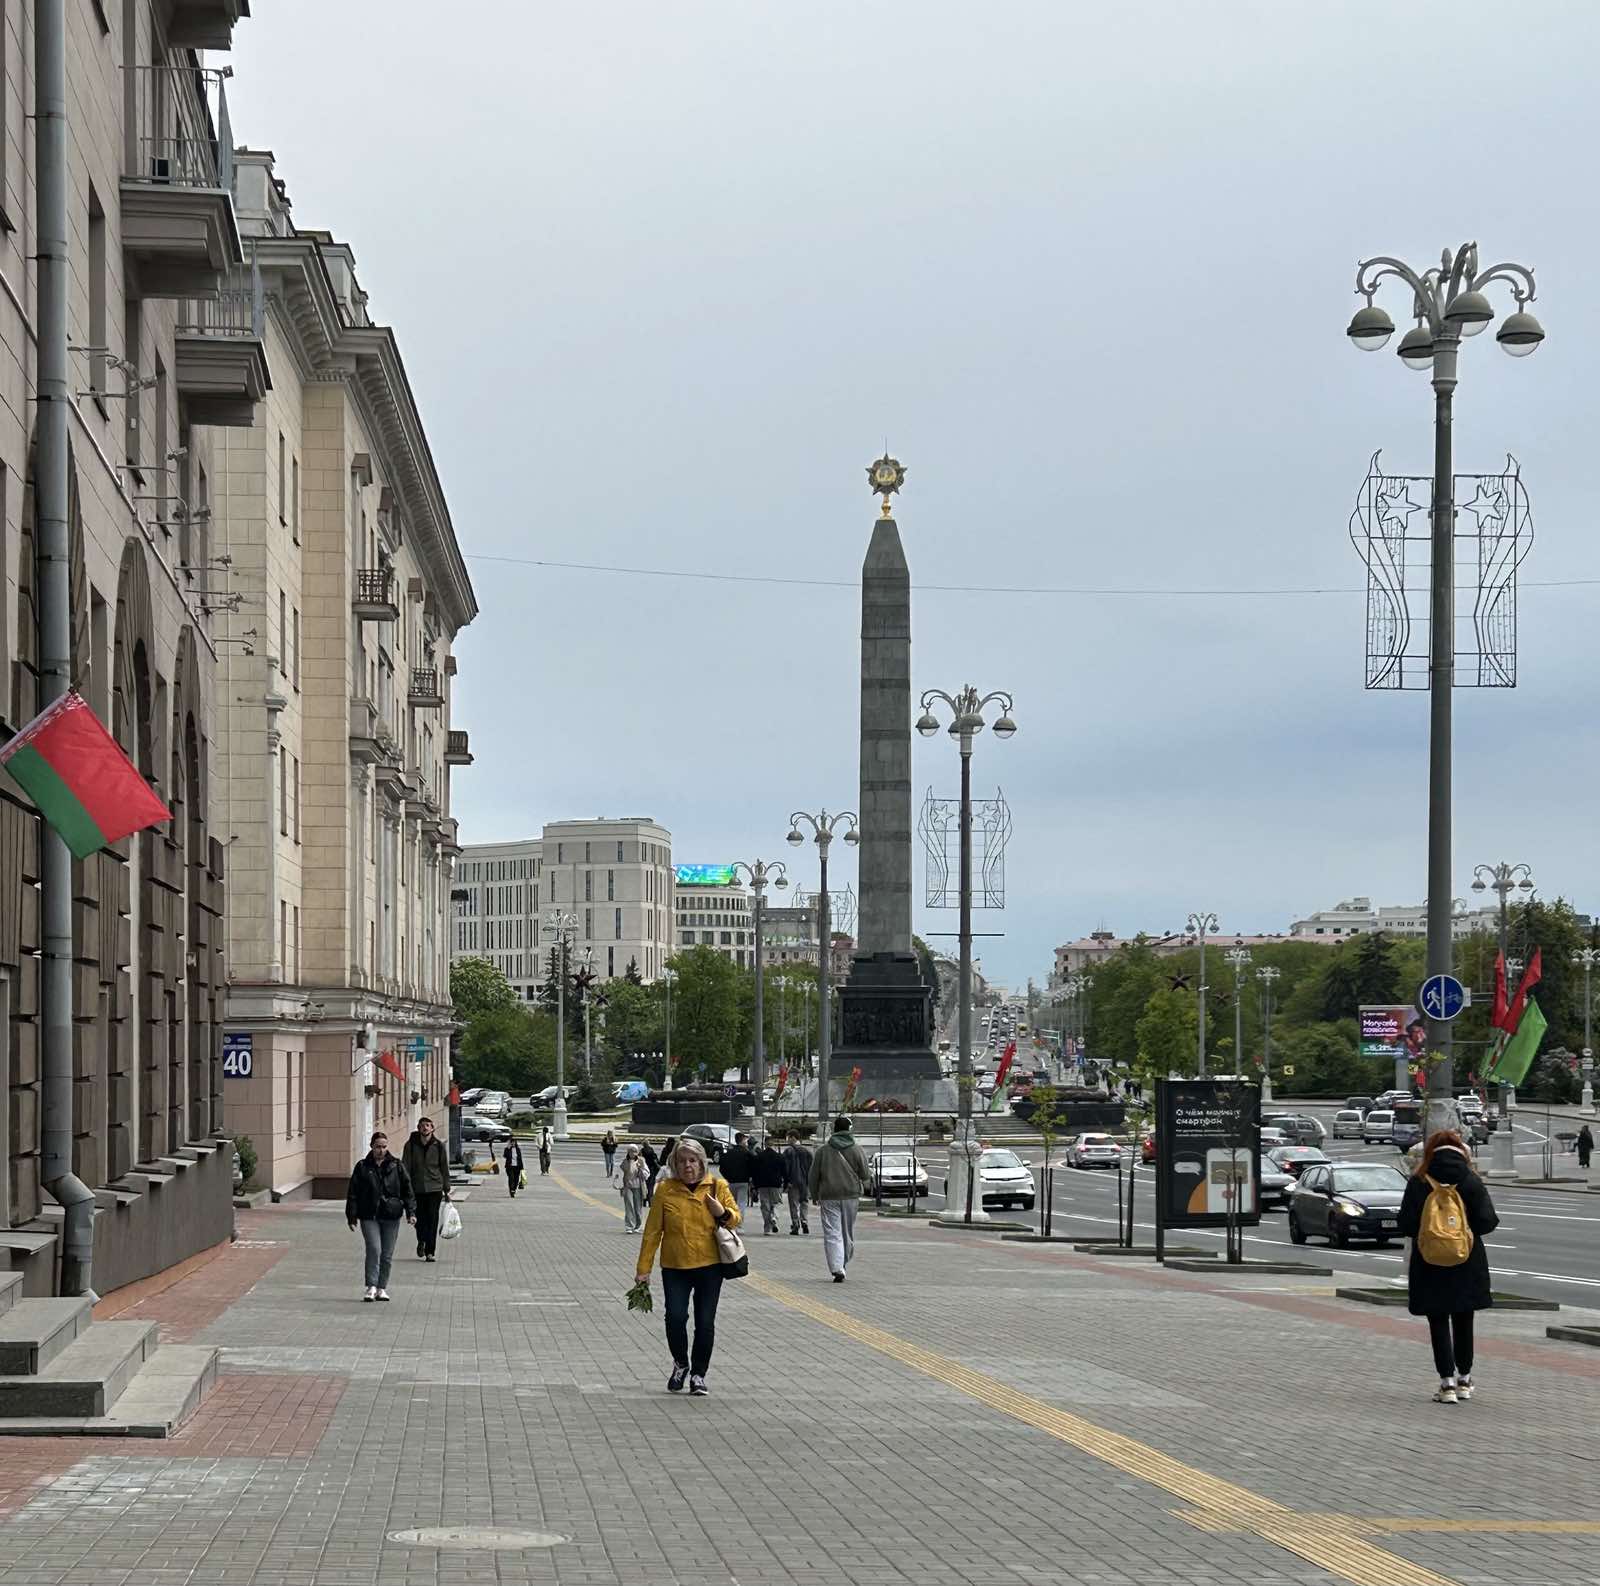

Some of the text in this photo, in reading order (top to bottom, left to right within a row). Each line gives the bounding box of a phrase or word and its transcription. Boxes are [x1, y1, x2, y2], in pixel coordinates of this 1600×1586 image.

[224, 1050, 252, 1075] 40
[1175, 1108, 1184, 1116] О
[1175, 1118, 1224, 1127] смартфон
